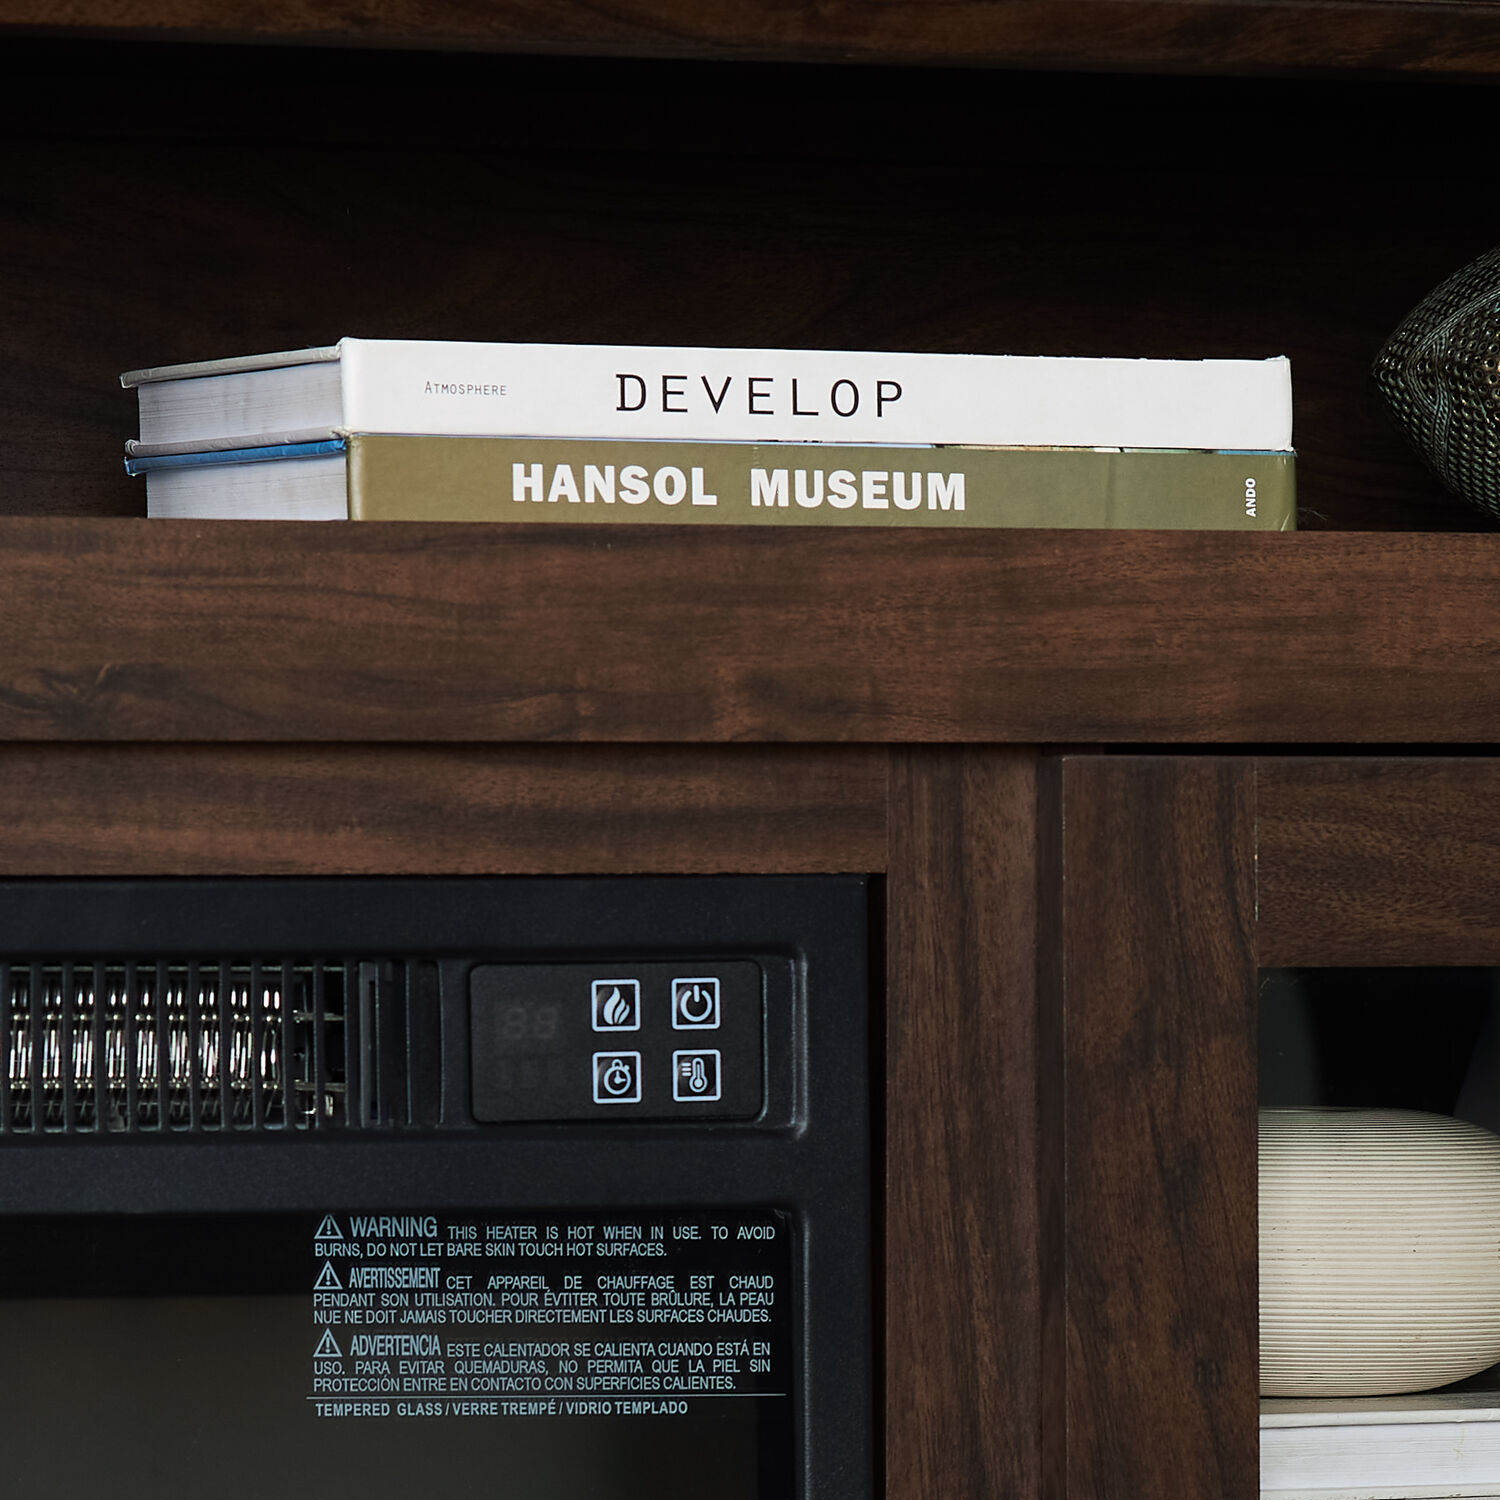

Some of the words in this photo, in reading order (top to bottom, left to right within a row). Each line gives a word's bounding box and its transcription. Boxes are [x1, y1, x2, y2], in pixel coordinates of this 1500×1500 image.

[616, 374, 905, 418] DEVELOP
[511, 463, 718, 508] HANSOL
[750, 468, 968, 513] MUSEUM
[1245, 477, 1257, 518] ANDO
[350, 1217, 438, 1238] WARNING
[448, 1226, 478, 1240] THIS
[486, 1226, 538, 1240] HEATER
[546, 1226, 559, 1240] IS
[567, 1226, 595, 1240] HOT
[603, 1226, 643, 1240] WHEN
[651, 1226, 664, 1240] IN
[673, 1226, 702, 1240] USE.
[711, 1226, 729, 1240] TO
[737, 1226, 776, 1240] AVOID
[315, 1243, 364, 1259] BURNS,
[367, 1243, 387, 1257] DO
[391, 1243, 418, 1257] NOT
[421, 1243, 444, 1257] LET
[447, 1243, 482, 1257] BARE
[485, 1243, 515, 1257] SKIN
[518, 1243, 563, 1257] TOUCH
[567, 1243, 596, 1257] HOT
[597, 1243, 668, 1257] SURFACES.
[349, 1267, 441, 1289] AVERTISSEMENT
[446, 1276, 473, 1290] CET
[488, 1276, 550, 1290] APPAREIL
[564, 1276, 583, 1289] DE
[597, 1276, 675, 1289] CHAUFFAGE
[690, 1276, 716, 1289] EST
[729, 1276, 774, 1289] CHAUD
[314, 1294, 376, 1307] PENDANT
[381, 1293, 410, 1307] SON
[415, 1293, 496, 1307] UTILISATION.
[502, 1293, 539, 1307] POUR
[545, 1289, 598, 1307] ÉVTITER
[603, 1293, 646, 1307] TOUTE
[651, 1290, 714, 1309] BRÛLURE,
[720, 1293, 736, 1306] LA
[740, 1292, 774, 1306] PEAU
[314, 1310, 342, 1325] NUE
[345, 1310, 363, 1324] NE
[366, 1310, 398, 1324] DOIT
[400, 1310, 447, 1324] JAMAIS
[450, 1310, 512, 1324] TOUCHER
[516, 1310, 607, 1324] DIRECTEMENT
[610, 1310, 634, 1324] LES
[637, 1310, 705, 1323] SURFACES
[708, 1310, 772, 1323] CHAUDES.
[350, 1335, 442, 1357] ADVERTENCIA
[447, 1344, 481, 1358] ESTE
[484, 1344, 570, 1358] CALENTADOR
[574, 1344, 591, 1357] SE
[595, 1344, 656, 1357] CALIENTA
[659, 1343, 713, 1357] CUANDO
[717, 1340, 750, 1357] ESTÁ
[754, 1343, 771, 1356] EN
[314, 1361, 346, 1375] USO.
[356, 1361, 391, 1375] PARA
[399, 1361, 445, 1375] EVITAR
[454, 1361, 549, 1376] QUEMADURAS,
[559, 1360, 578, 1374] NO
[588, 1360, 644, 1374] PERMITA
[652, 1360, 680, 1374] QUE
[689, 1360, 705, 1374] LA
[713, 1360, 741, 1374] PIEL
[750, 1359, 771, 1373] SIN
[314, 1375, 400, 1393] PROTECCIÓN
[404, 1378, 447, 1392] ENTRE
[451, 1378, 468, 1392] EN
[471, 1377, 542, 1392] CONTACTO
[545, 1377, 574, 1391] CON
[577, 1377, 661, 1391] SUPERFICIES
[664, 1376, 737, 1390] CALIENTES.
[316, 1403, 391, 1417] TEMPERED
[397, 1402, 443, 1417] GLASS
[453, 1402, 499, 1416] VERRE
[502, 1399, 557, 1416] TREMPÉ
[566, 1401, 612, 1415] VIDRIO
[615, 1401, 688, 1415] TEMPLADO
